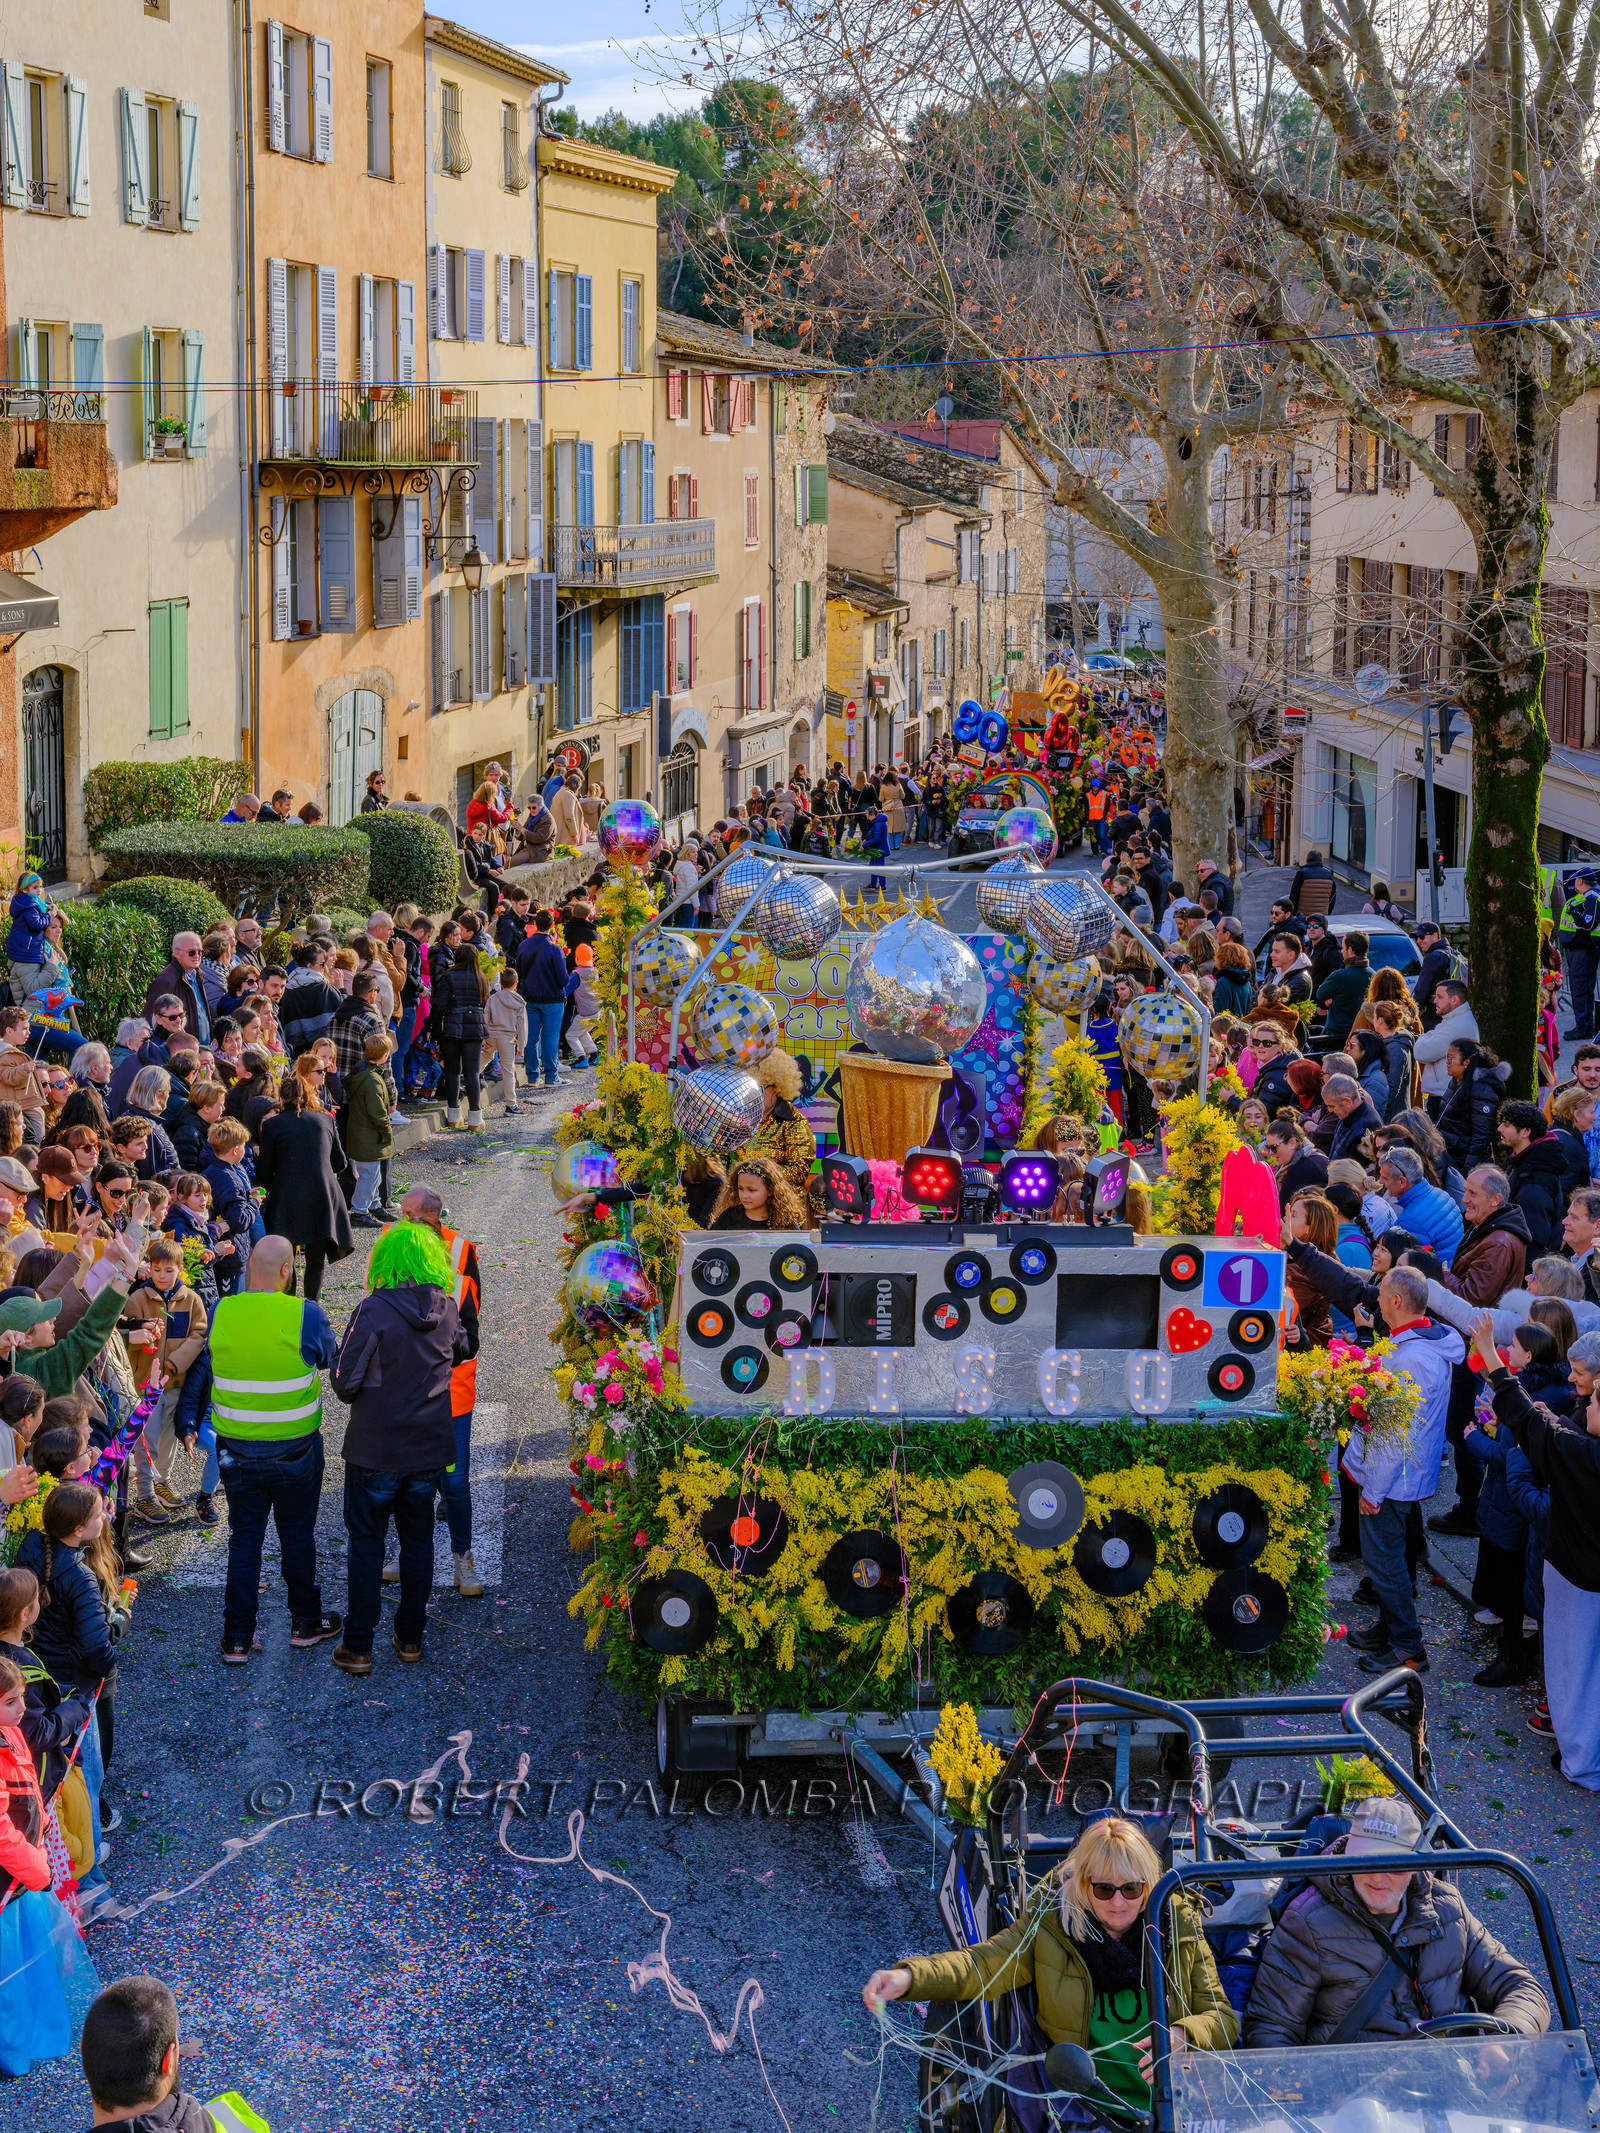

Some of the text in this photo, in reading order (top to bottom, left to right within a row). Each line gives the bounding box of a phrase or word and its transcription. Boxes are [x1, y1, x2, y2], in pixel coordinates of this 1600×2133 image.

[8, 609, 25, 620] SONS
[1006, 651, 1022, 659] CBD
[1229, 1258, 1254, 1303] 1
[876, 1279, 892, 1341] MIPRO
[782, 1344, 1172, 1416] DISCO
[1363, 1818, 1398, 1835] MALTA
